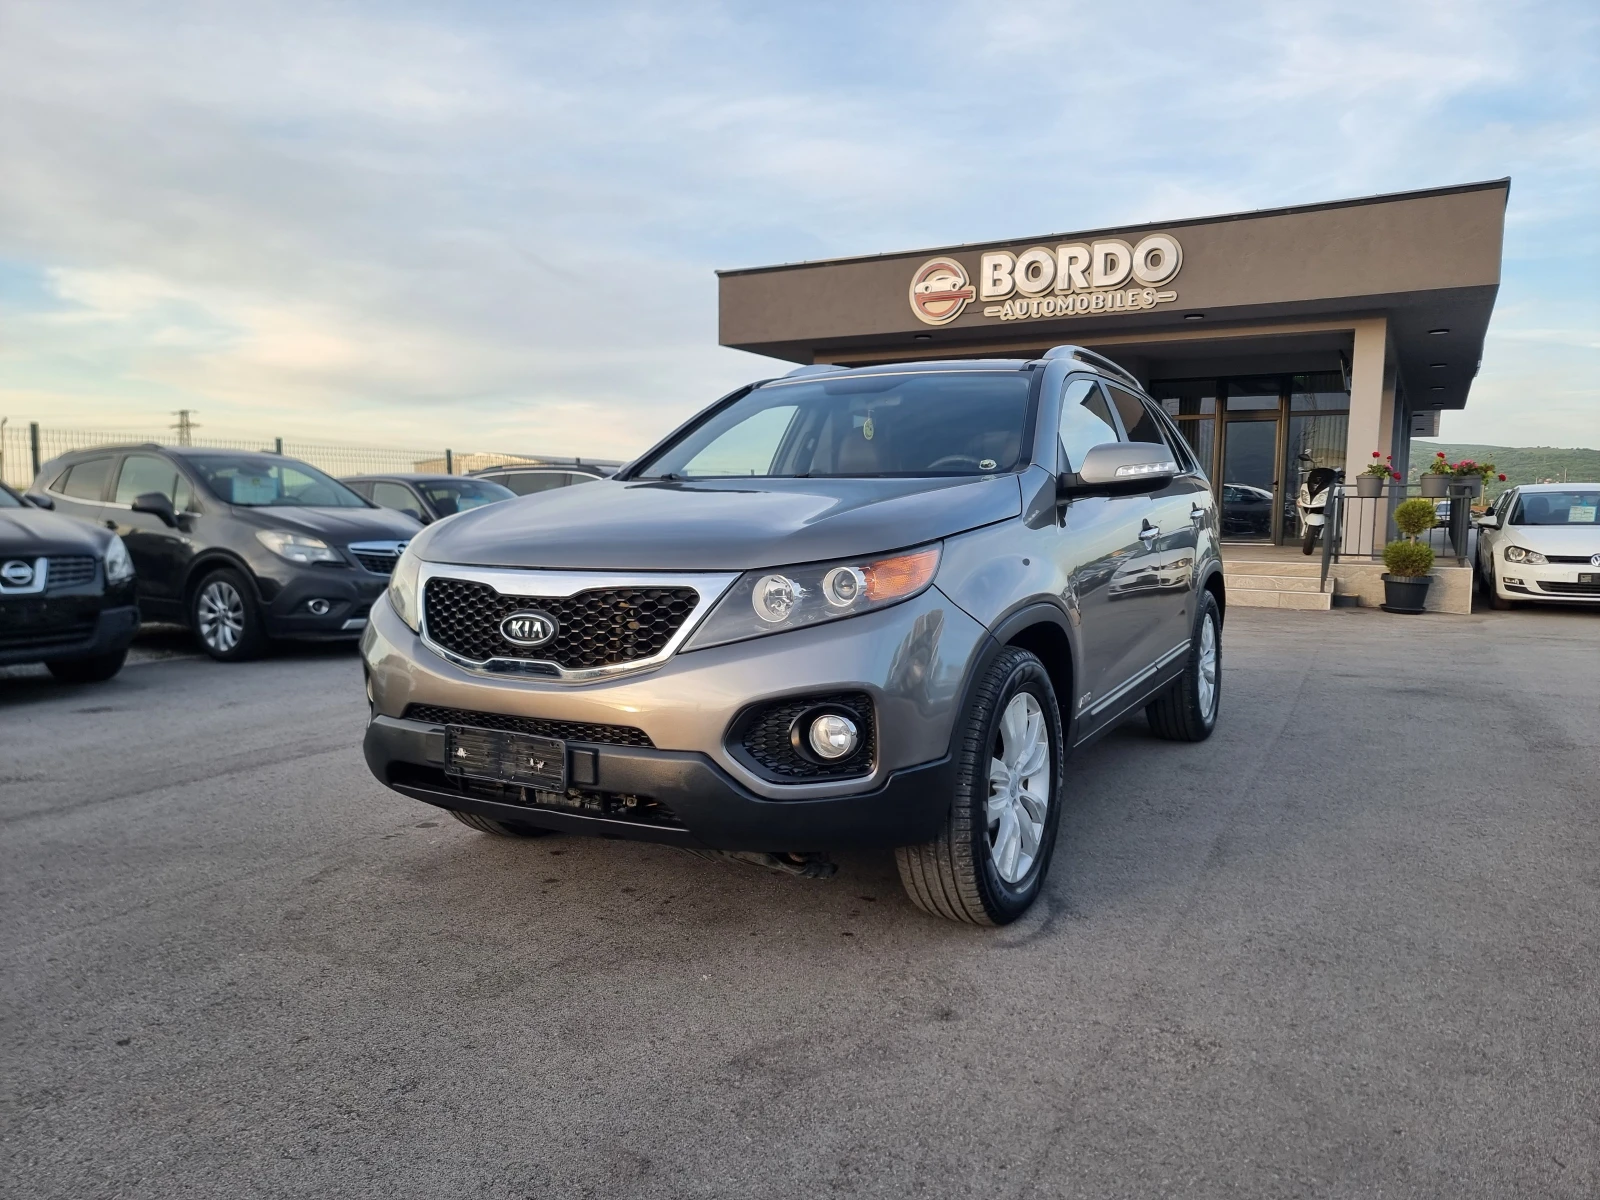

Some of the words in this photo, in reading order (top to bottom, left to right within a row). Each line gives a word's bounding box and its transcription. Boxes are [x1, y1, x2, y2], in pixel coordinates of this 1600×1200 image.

[982, 236, 1180, 298] BORDO
[1002, 290, 1155, 317] AUTOMOBILES
[511, 620, 544, 639] KIA
